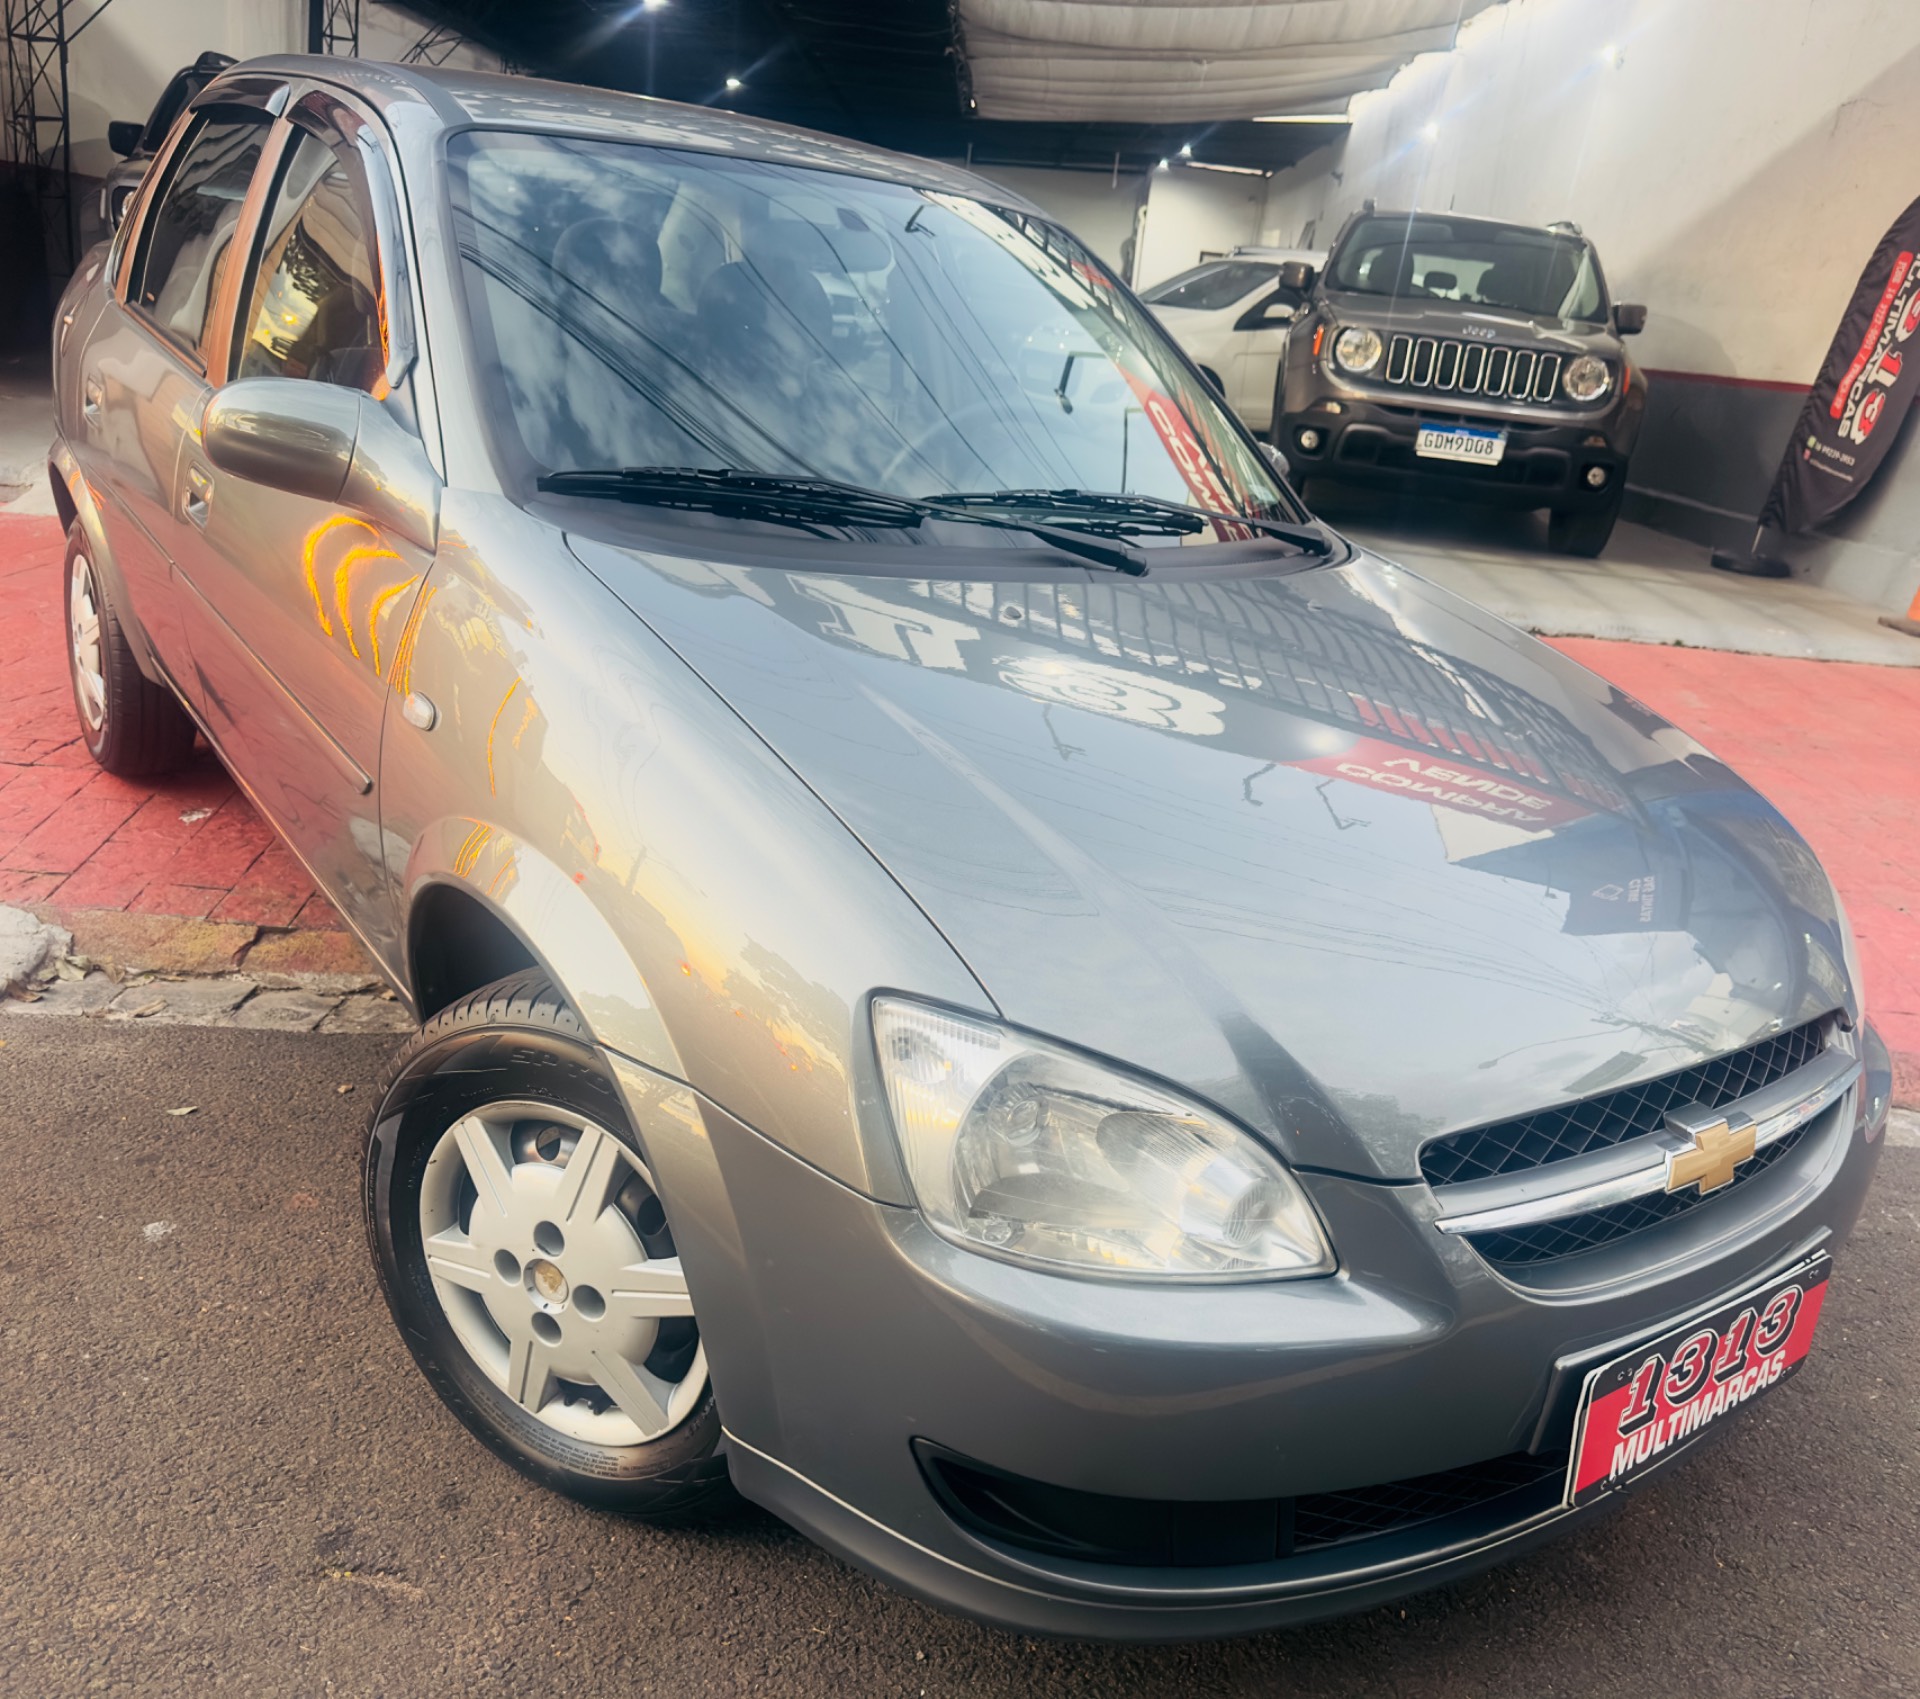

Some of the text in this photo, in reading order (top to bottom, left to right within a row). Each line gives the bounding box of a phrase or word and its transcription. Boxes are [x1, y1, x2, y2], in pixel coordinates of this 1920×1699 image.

[1462, 325, 1496, 339] Jeep
[1423, 432, 1495, 455] GDM9D08
[1617, 1284, 1804, 1439] 1313
[1609, 1350, 1786, 1481] MULTIMARCAS
